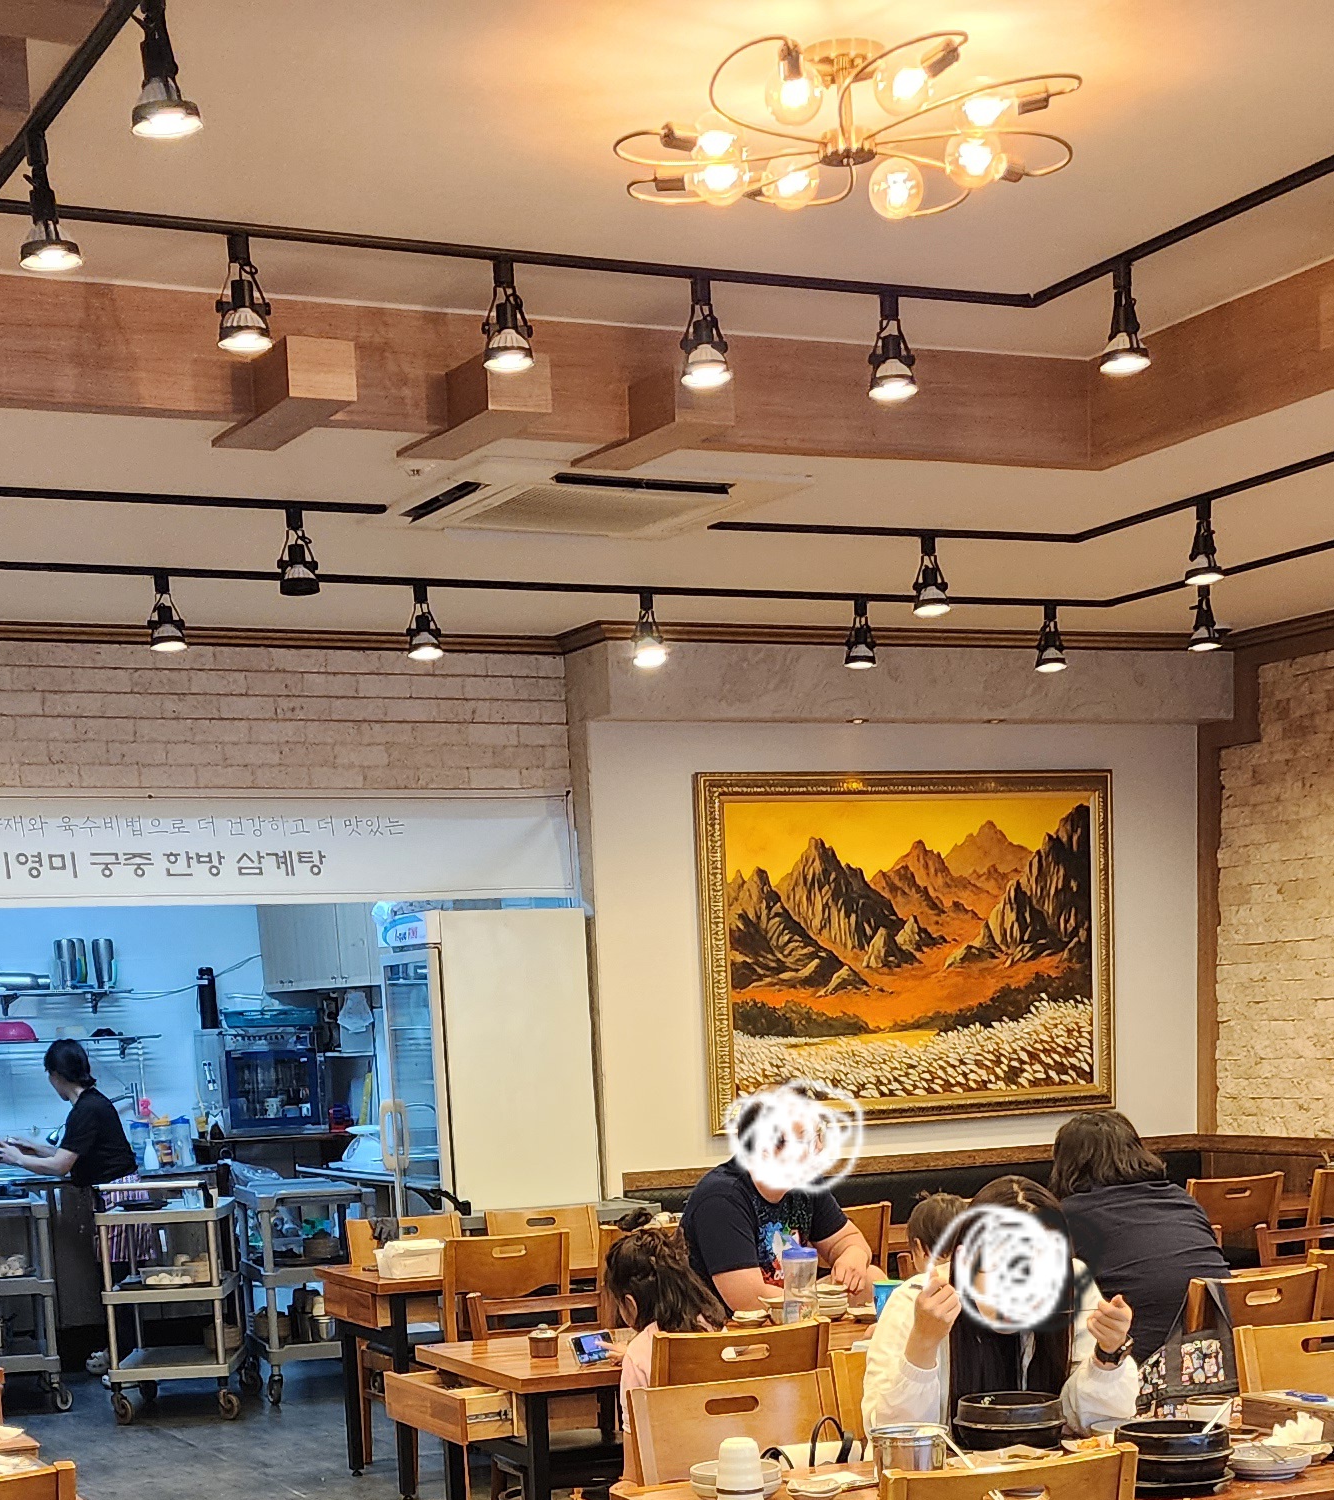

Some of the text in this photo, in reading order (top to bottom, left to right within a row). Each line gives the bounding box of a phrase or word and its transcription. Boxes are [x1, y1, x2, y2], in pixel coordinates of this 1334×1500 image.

[56, 815, 191, 838] 육수비법으로
[197, 815, 216, 837] 더
[226, 815, 311, 837] 건강하고
[317, 815, 335, 837] 더
[343, 815, 406, 837] 맛있는
[89, 851, 155, 878] 궁중
[163, 850, 226, 877] 한방
[236, 850, 327, 877] 삼계탕
